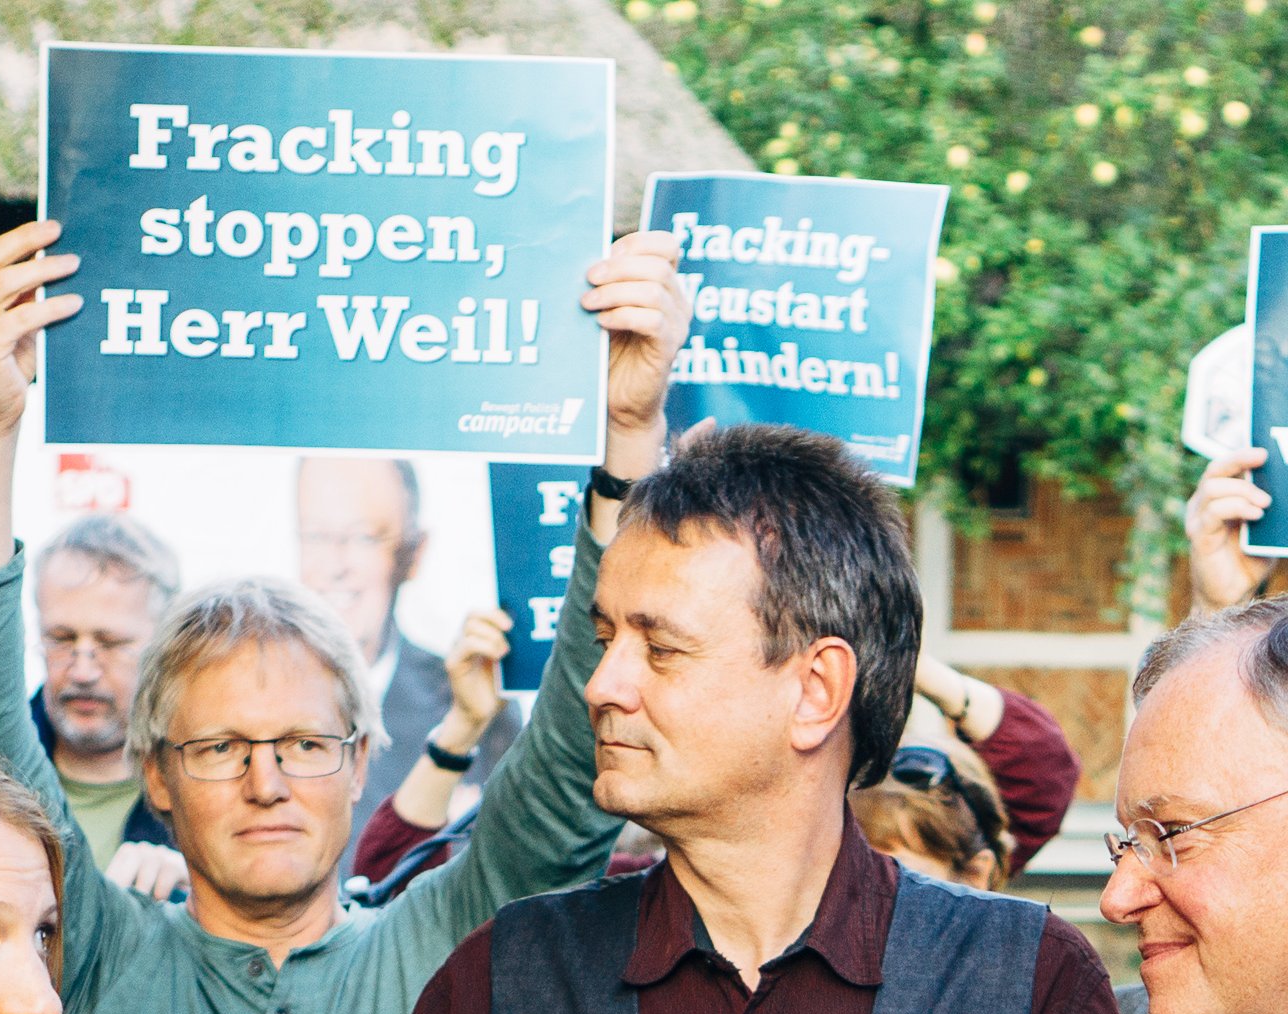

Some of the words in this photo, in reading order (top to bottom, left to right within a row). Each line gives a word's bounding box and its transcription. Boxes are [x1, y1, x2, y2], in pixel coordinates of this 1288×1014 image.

[129, 103, 526, 196] Fracking
[140, 194, 506, 278] stoppen,
[672, 212, 891, 283] Fracking-
[100, 288, 306, 359] Herr
[317, 295, 541, 365] Weil!
[669, 336, 901, 399] rhindern!
[458, 398, 585, 438] campact!
